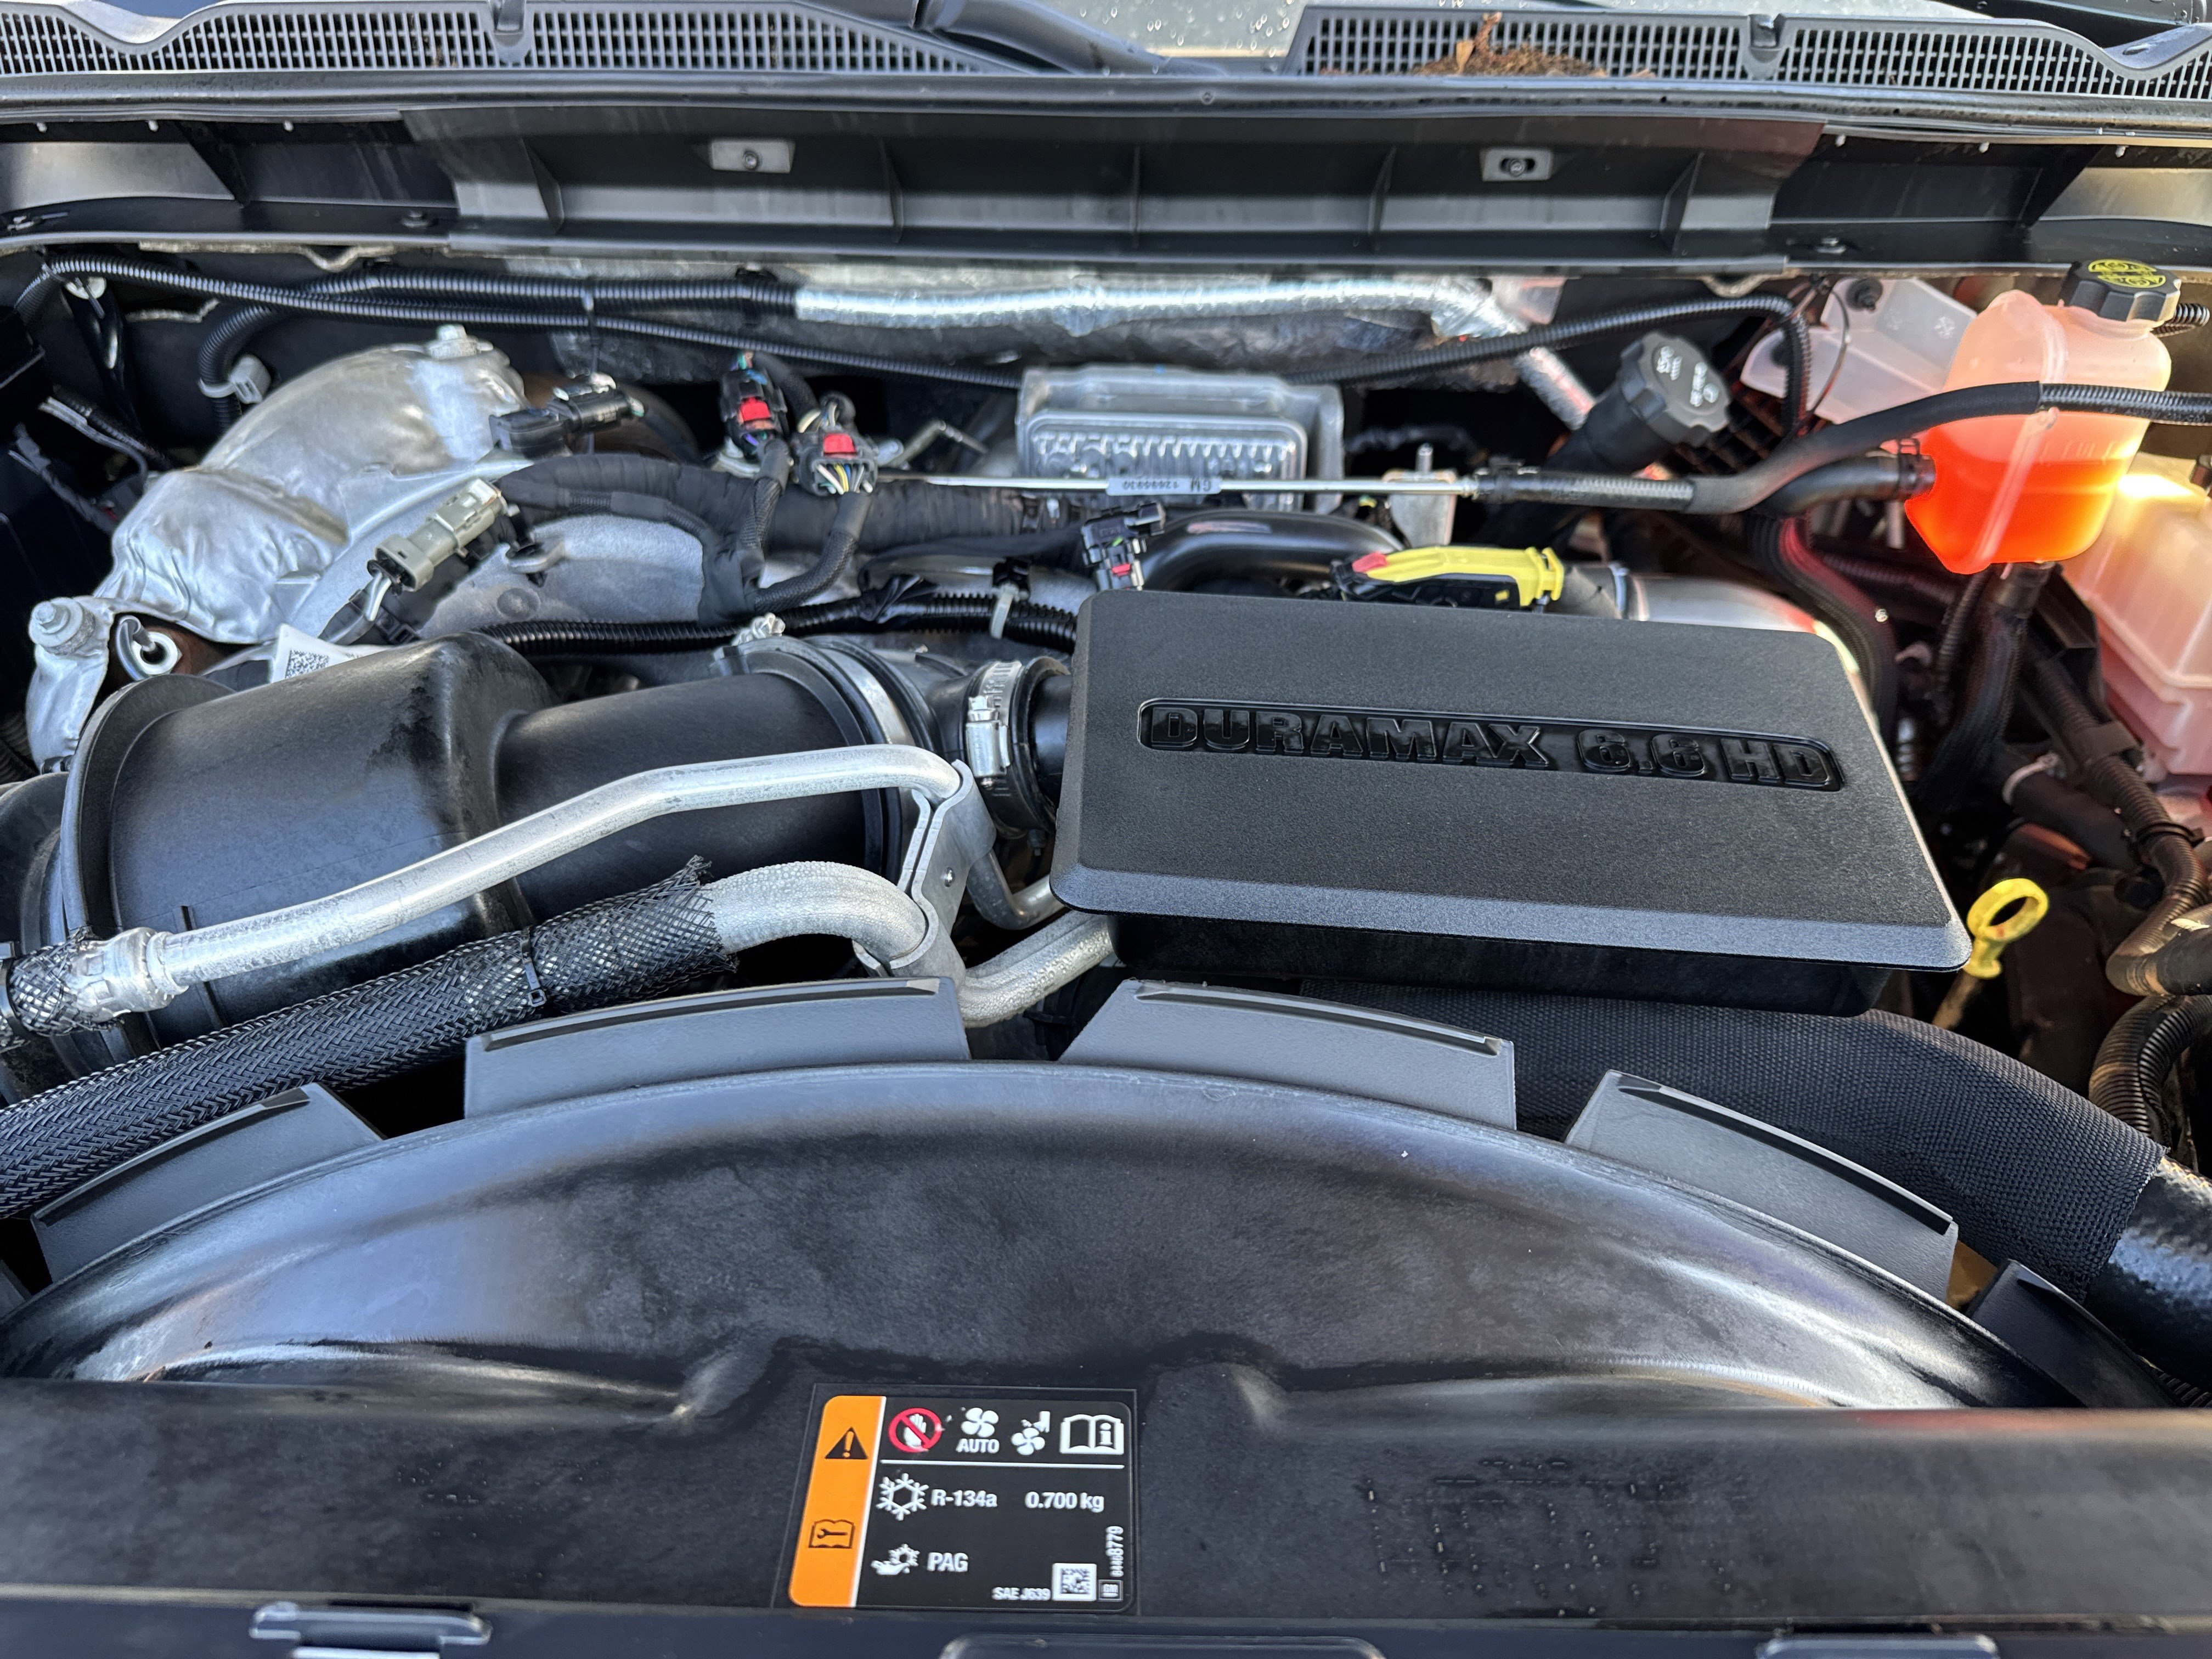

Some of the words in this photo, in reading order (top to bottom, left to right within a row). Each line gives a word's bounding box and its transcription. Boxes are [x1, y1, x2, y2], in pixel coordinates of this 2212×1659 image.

[1150, 706, 1550, 767] DURAMAX
[1577, 729, 1707, 777] 6.6
[1719, 737, 1832, 788] HD
[956, 1438, 1000, 1454] AUTO
[930, 1489, 998, 1508] R-134a
[1024, 1491, 1078, 1509] 0.700
[1080, 1492, 1104, 1513] kg
[927, 1552, 969, 1572] PAG
[992, 1587, 1019, 1600] SAE
